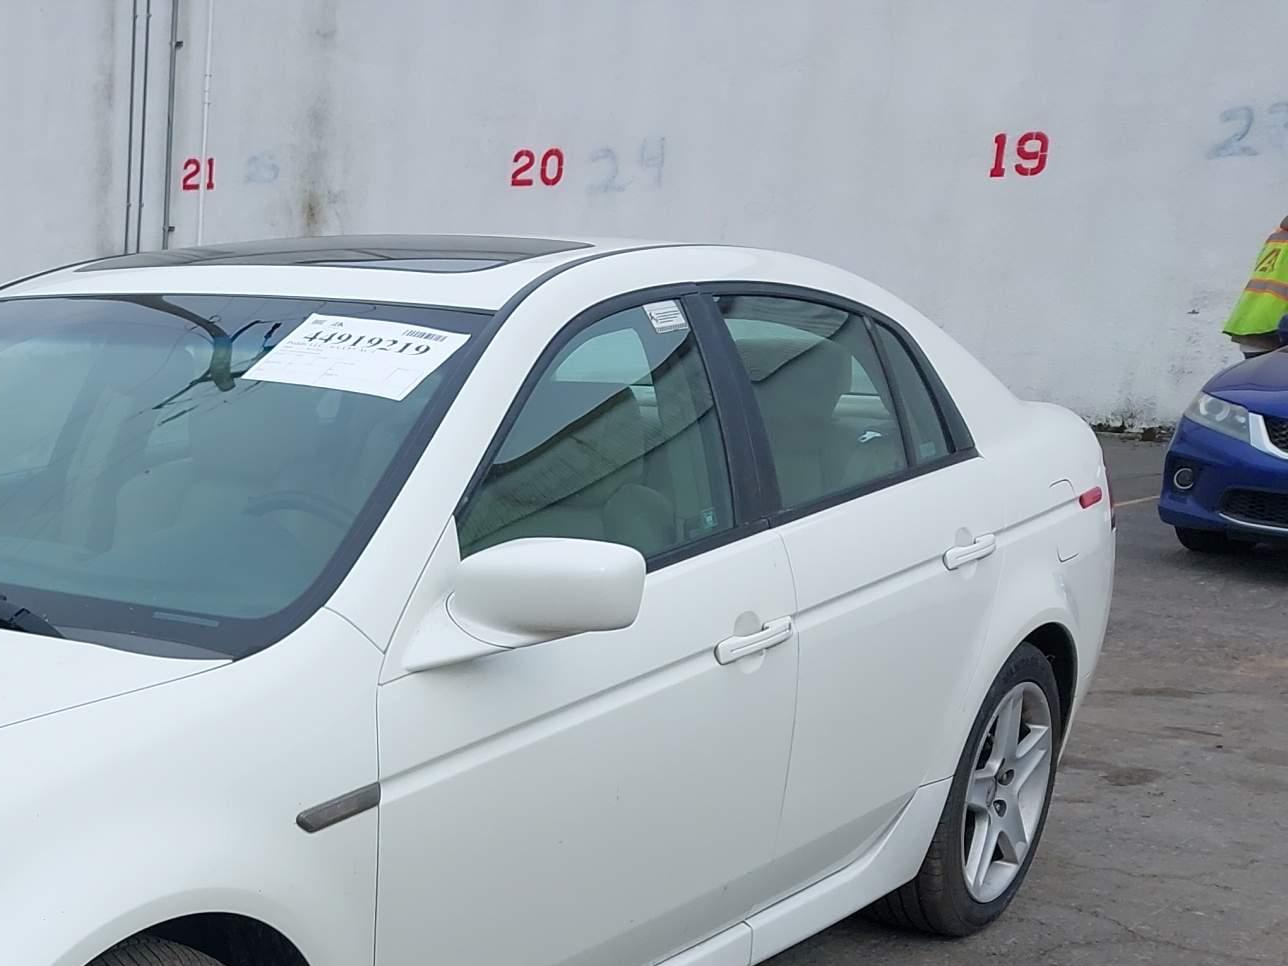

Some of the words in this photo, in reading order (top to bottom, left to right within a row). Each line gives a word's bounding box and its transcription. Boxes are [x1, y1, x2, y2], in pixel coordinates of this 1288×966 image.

[510, 146, 565, 188] 20
[988, 130, 1050, 178] 19
[182, 158, 215, 192] 21
[303, 330, 431, 356] 44919219
